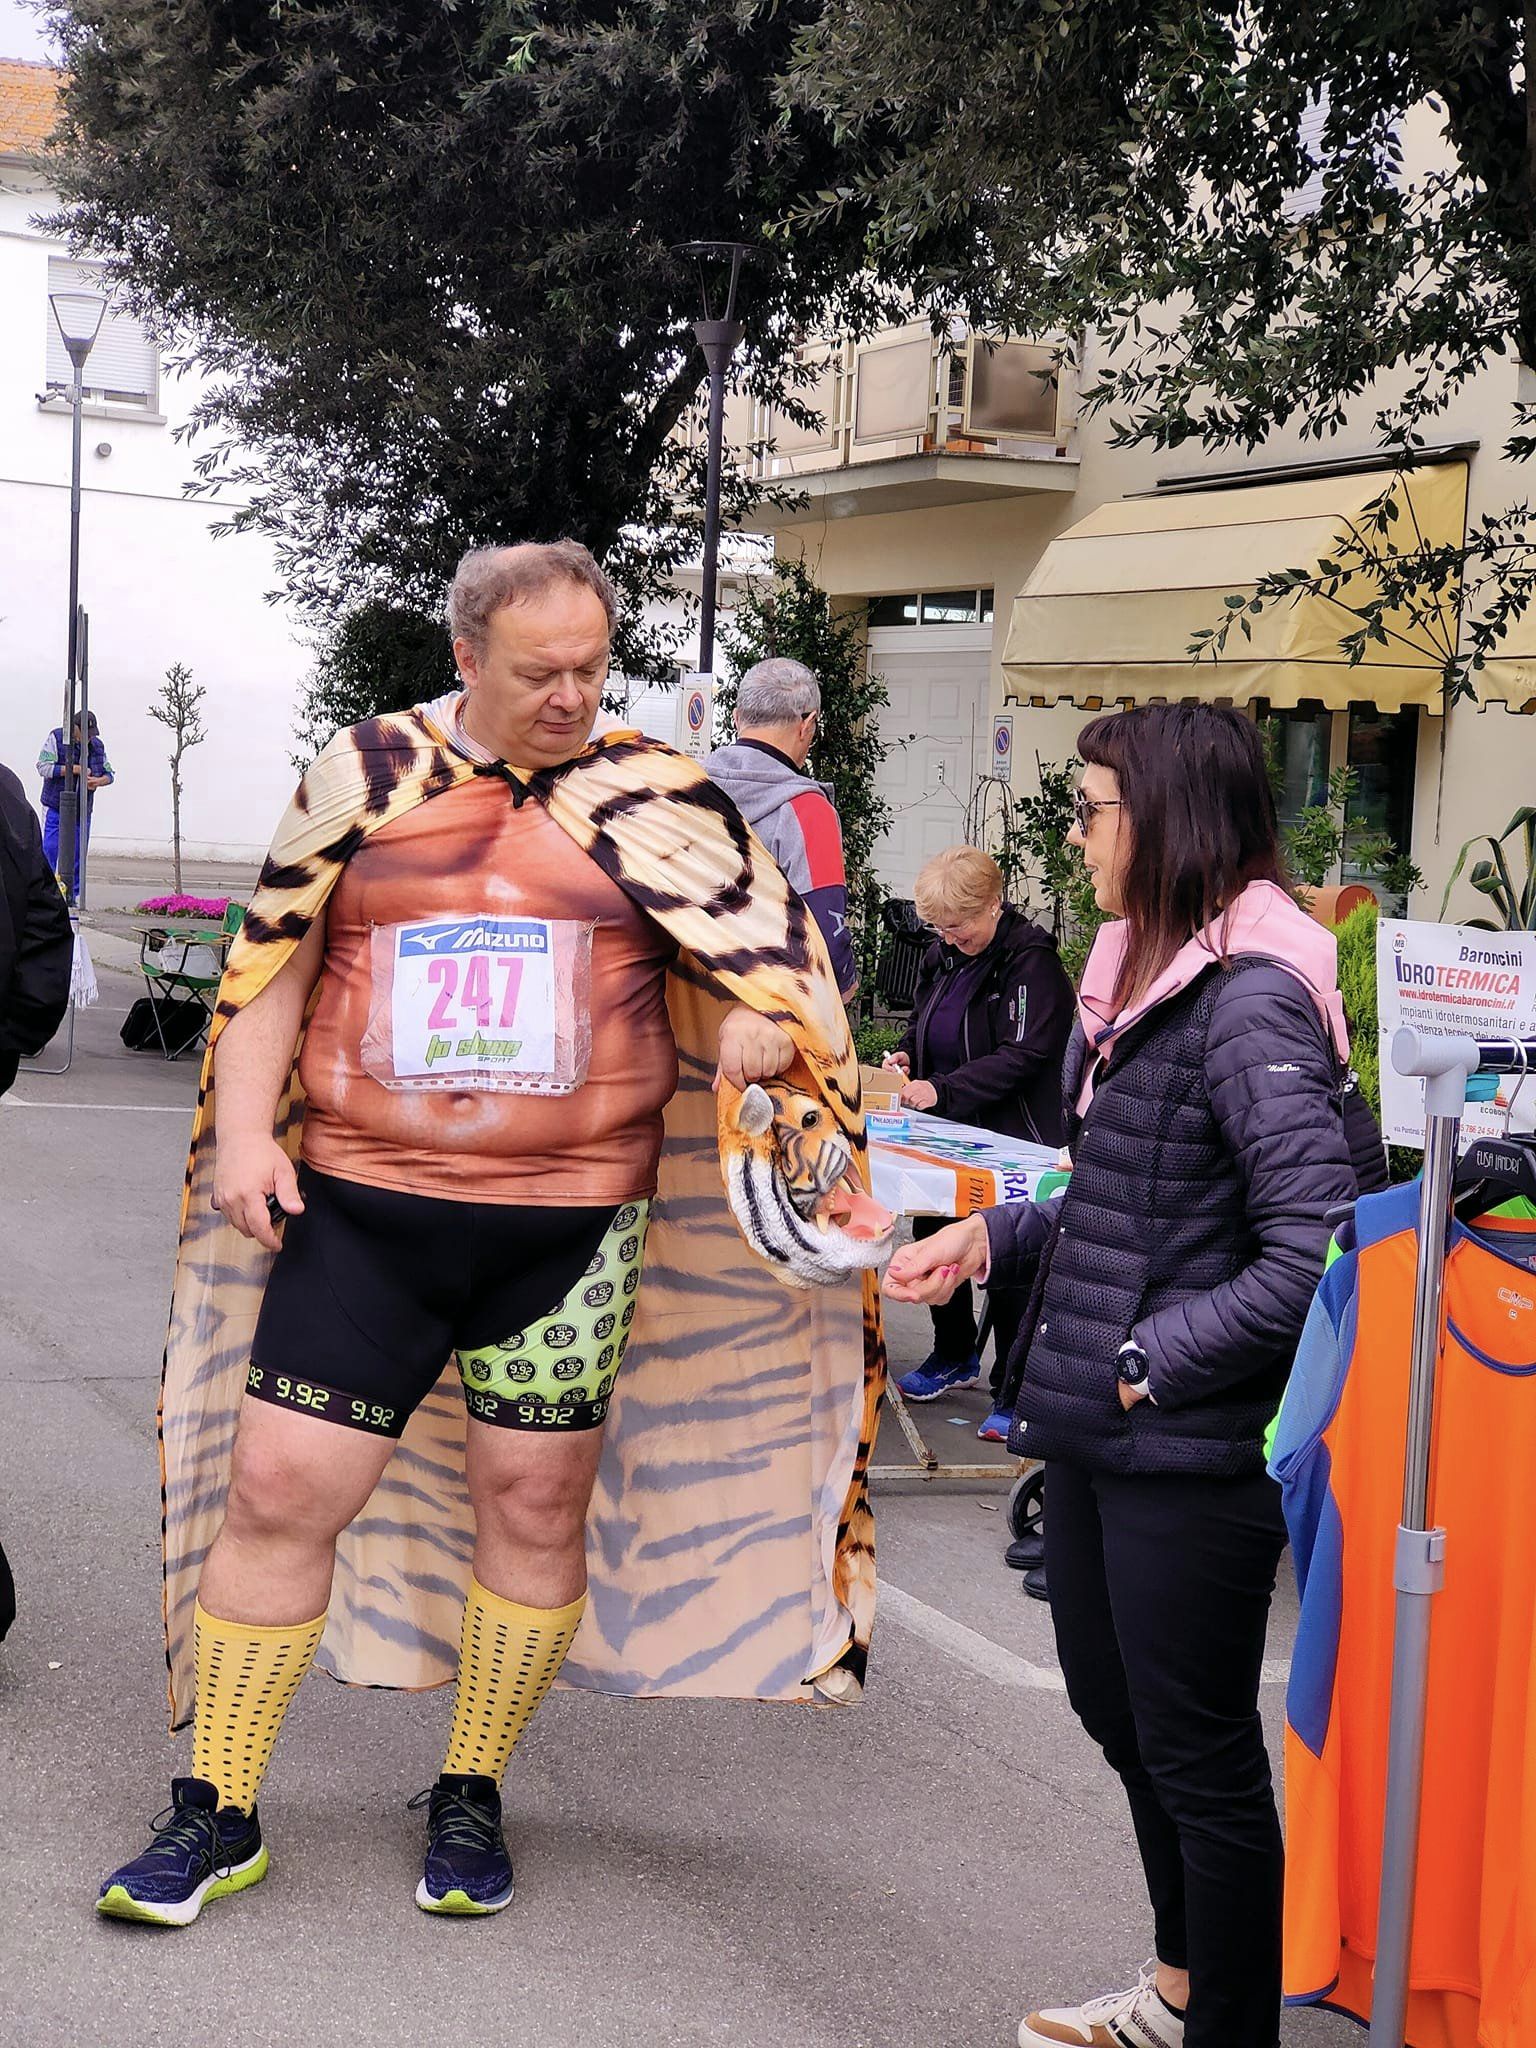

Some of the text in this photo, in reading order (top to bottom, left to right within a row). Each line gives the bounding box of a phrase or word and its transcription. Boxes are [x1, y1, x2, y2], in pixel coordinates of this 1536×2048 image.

[1459, 946, 1523, 967] Baroncini
[1395, 955, 1521, 996] IDROTERMICA
[427, 955, 524, 1030] 247
[1399, 988, 1516, 1010] www.idrotermicabaroncini.it
[1400, 1005, 1433, 1019] Impianti
[1435, 1009, 1517, 1030] idrotermosanitari
[1519, 1021, 1526, 1031] e
[588, 1287, 612, 1300] 9.92
[547, 1330, 574, 1341] 9.92
[509, 1364, 533, 1376] 9.92
[556, 1362, 582, 1374] 9.92
[276, 1376, 330, 1412] 9.92
[351, 1400, 395, 1428] 9.92
[467, 1389, 498, 1418] 9.92
[518, 1405, 575, 1425] 9.92
